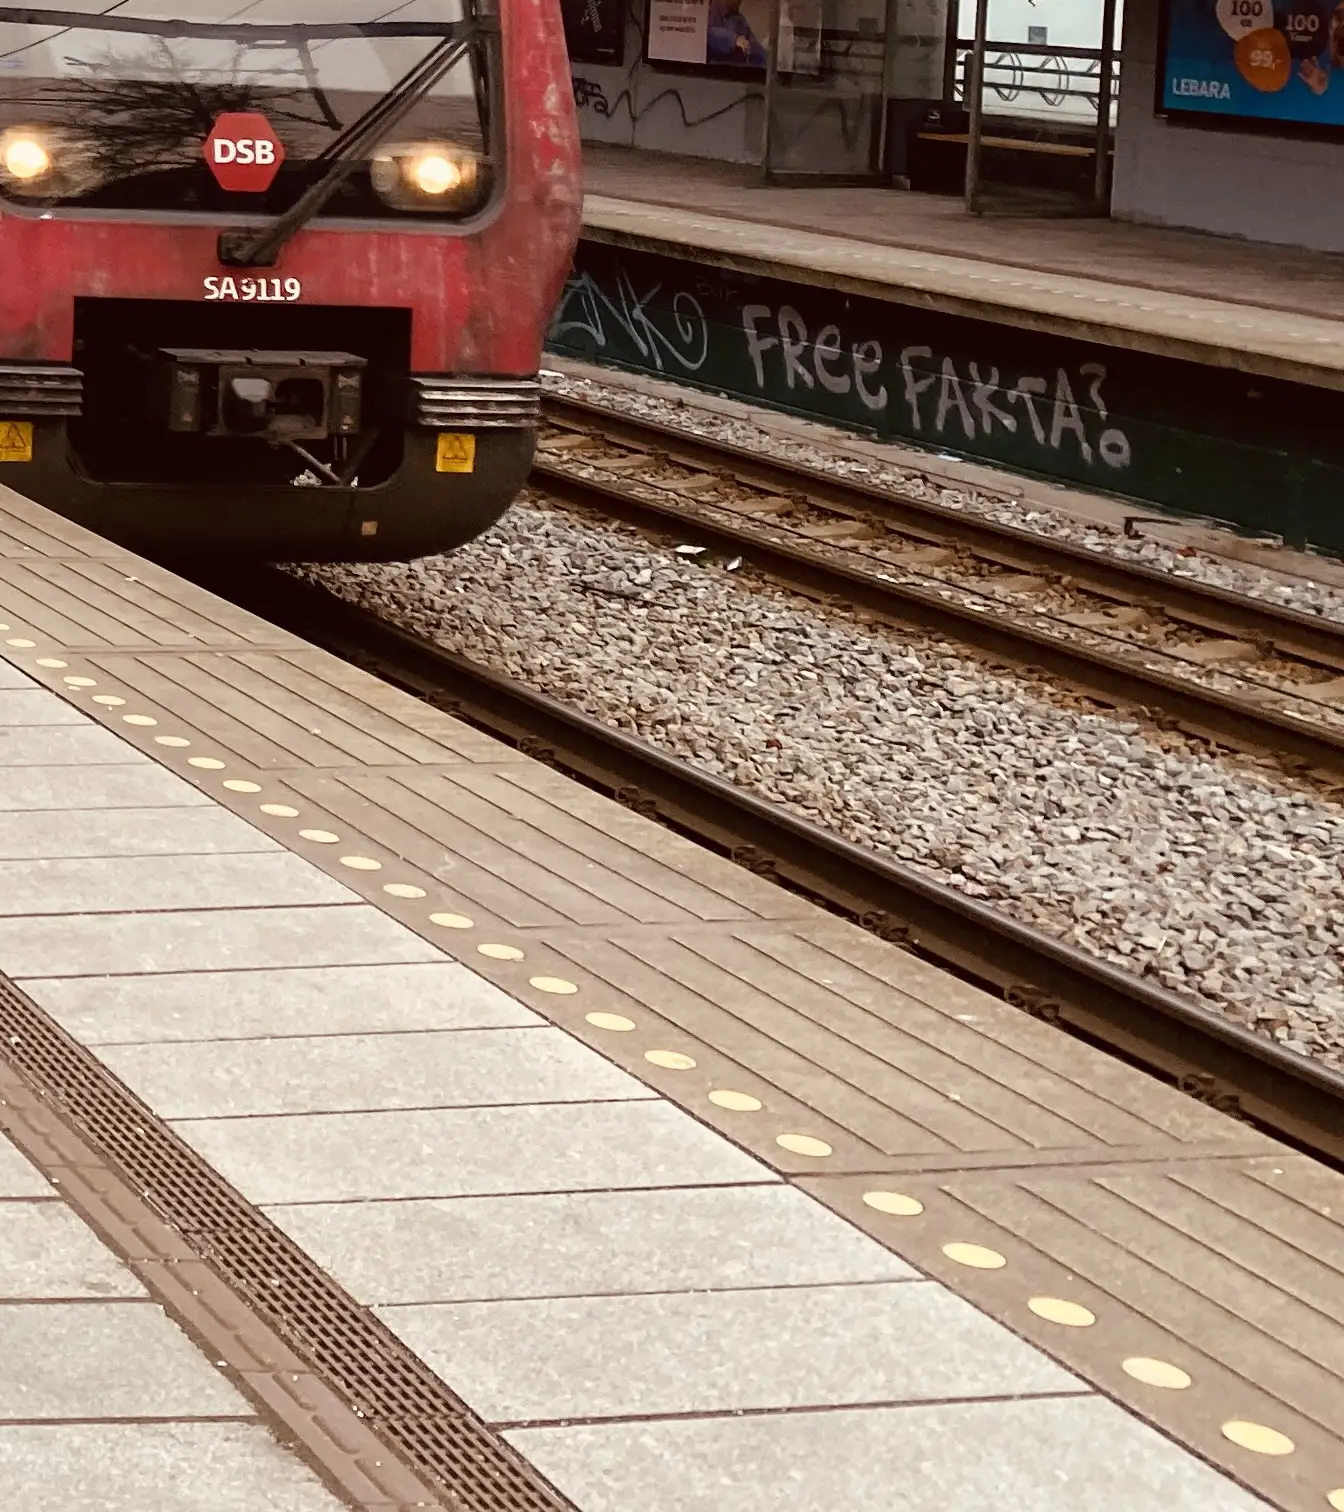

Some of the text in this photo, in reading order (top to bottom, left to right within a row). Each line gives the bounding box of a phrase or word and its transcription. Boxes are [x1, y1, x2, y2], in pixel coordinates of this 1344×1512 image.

[1231, 0, 1264, 17] 100
[1285, 14, 1320, 33] 100
[1172, 77, 1231, 100] LEBARA
[213, 138, 275, 165] DSB
